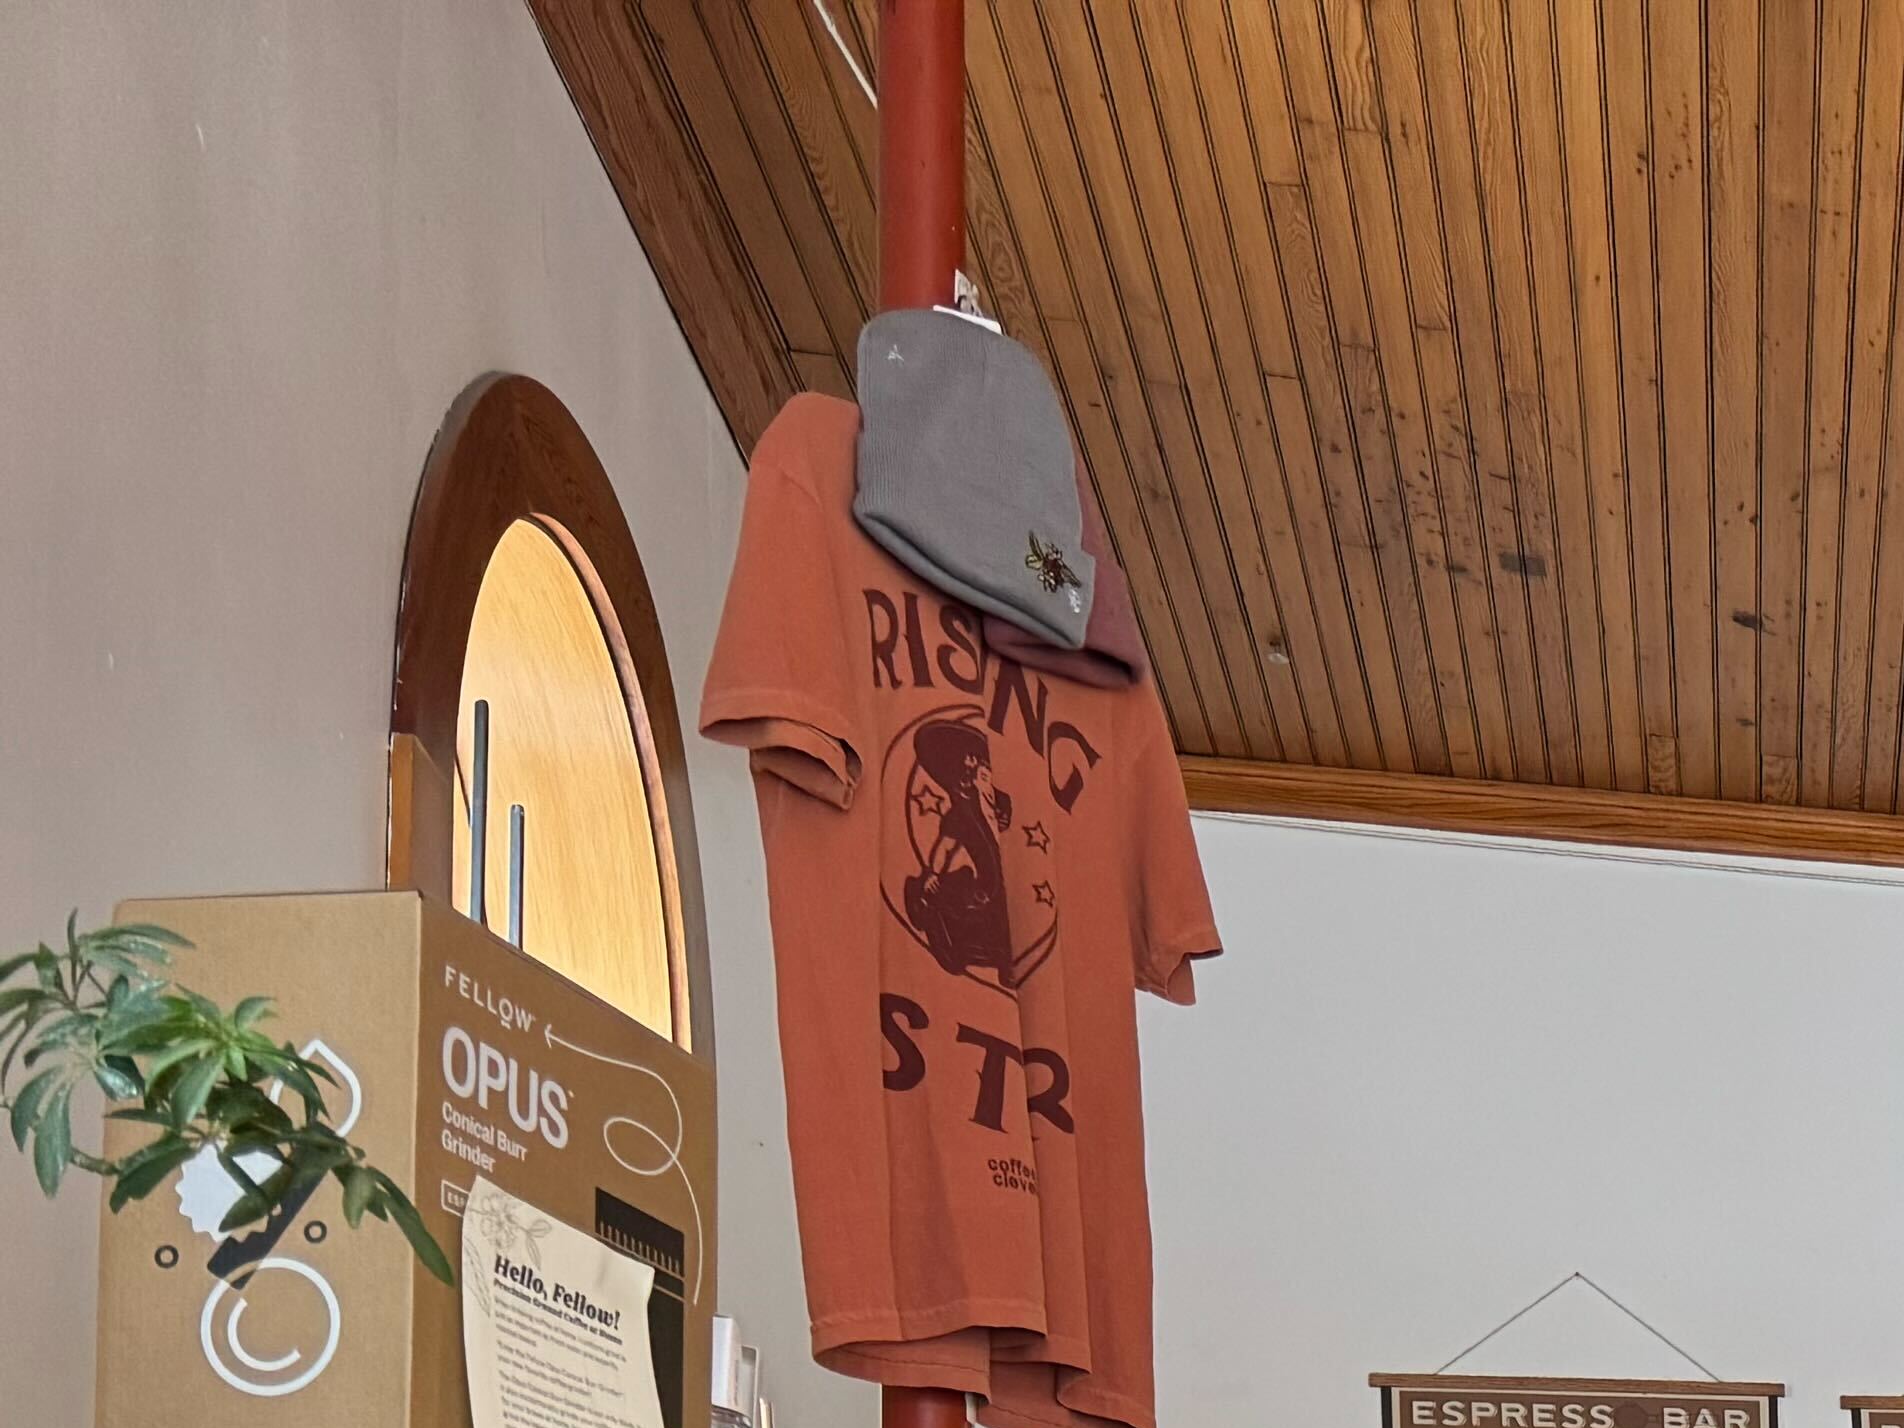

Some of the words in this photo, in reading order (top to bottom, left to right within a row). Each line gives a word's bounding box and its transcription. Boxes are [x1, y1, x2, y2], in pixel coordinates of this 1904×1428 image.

[862, 588, 1102, 815] RISNG
[444, 965, 533, 1032] FELLOW
[442, 1026, 569, 1149] OPUS
[880, 993, 1074, 1134] STR
[442, 1102, 494, 1146] Conical
[497, 1132, 528, 1161] Burr
[442, 1129, 496, 1173] Grinder
[494, 1255, 547, 1301] Hello,
[553, 1283, 621, 1330] Fellow!
